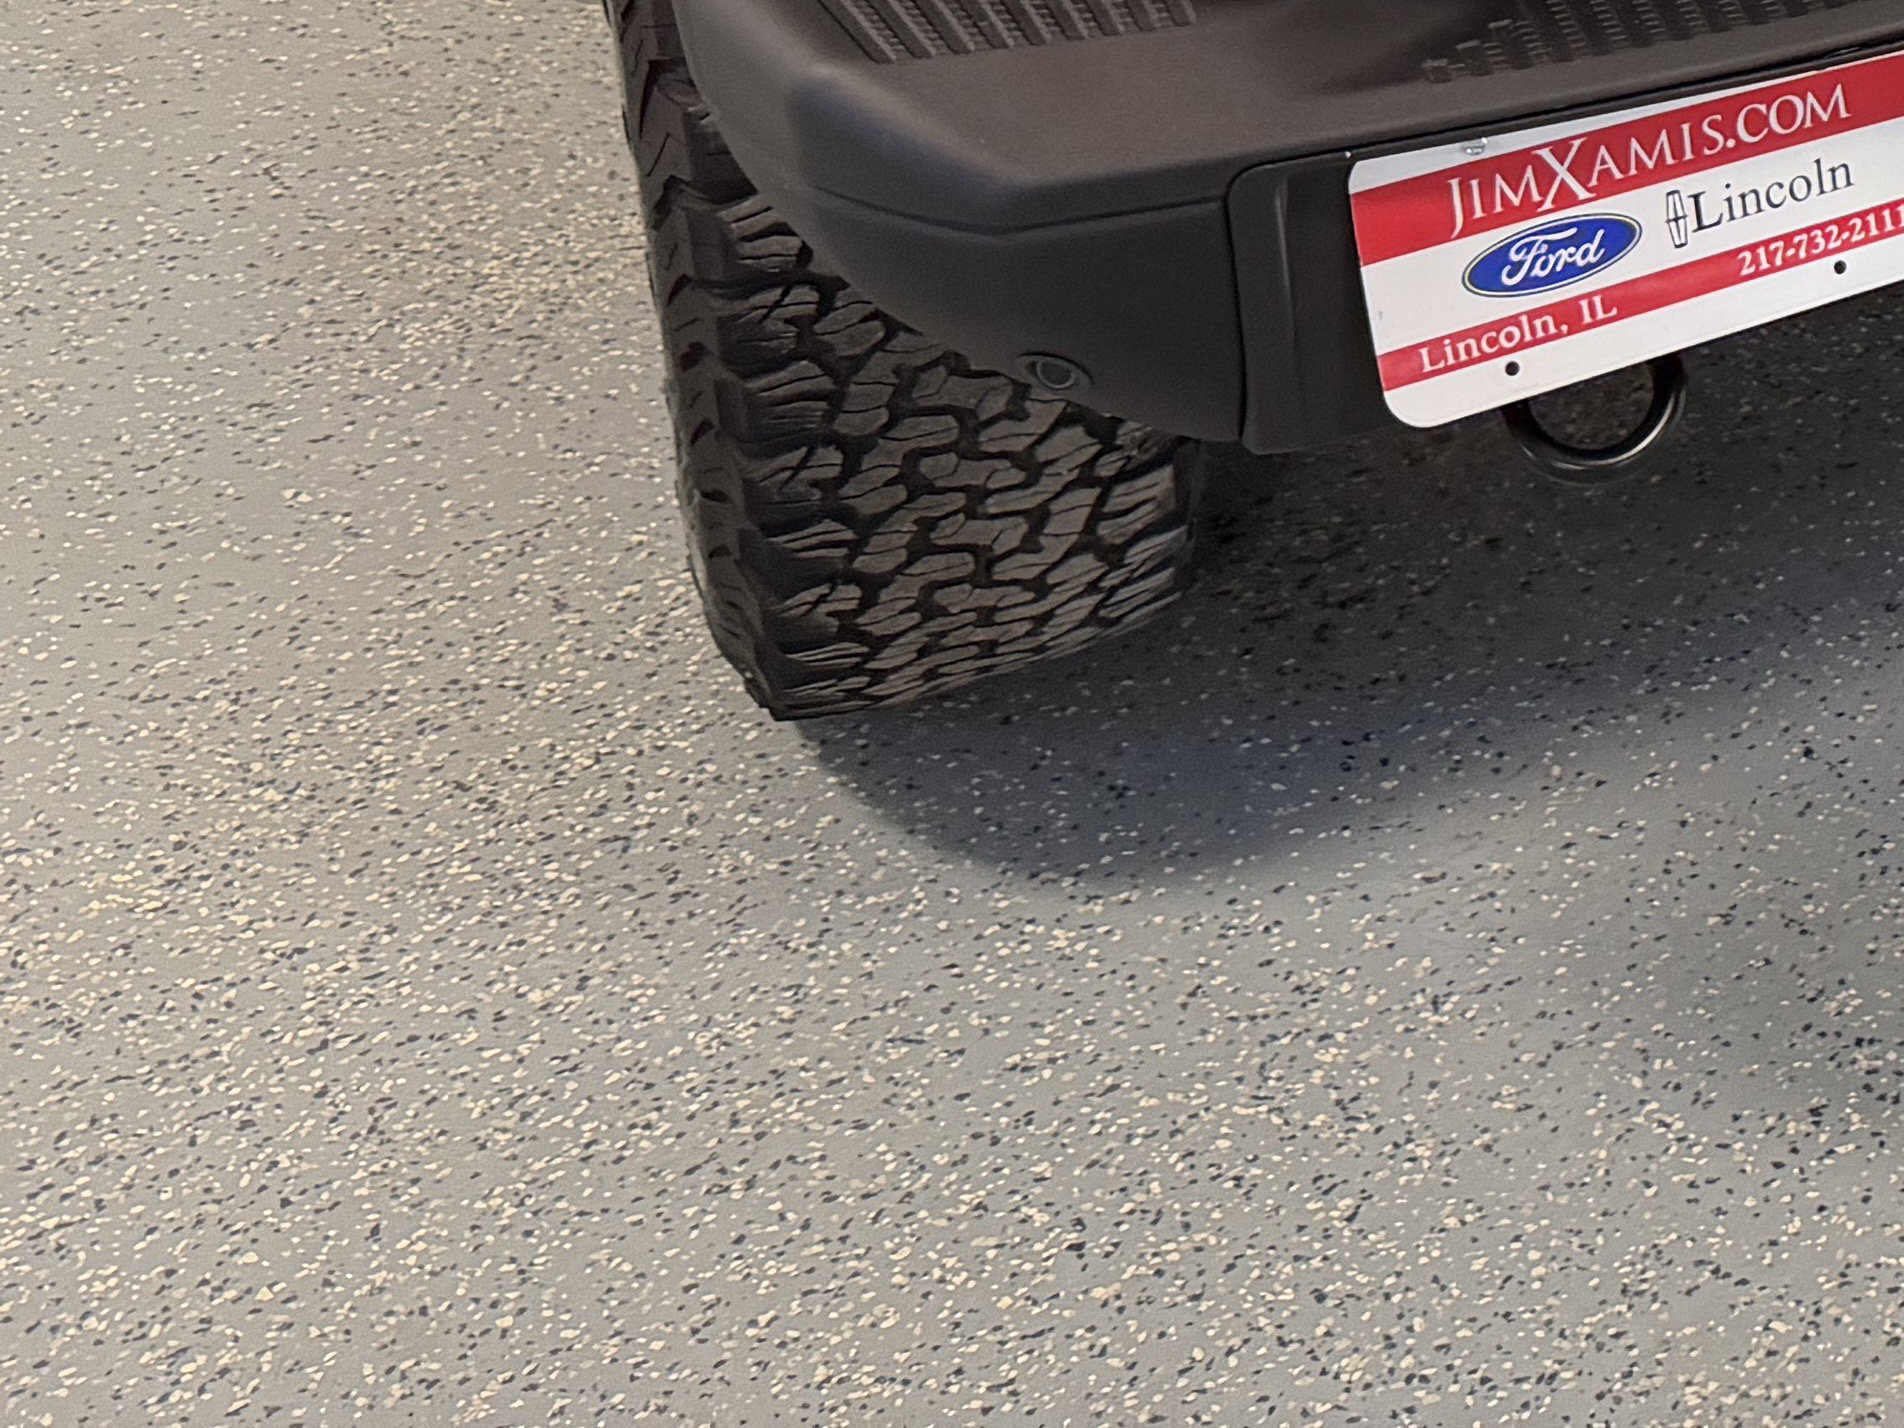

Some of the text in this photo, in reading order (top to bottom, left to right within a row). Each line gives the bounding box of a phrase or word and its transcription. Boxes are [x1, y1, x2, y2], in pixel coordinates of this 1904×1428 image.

[1448, 83, 1852, 239] JIMXAMIS.COM
[1688, 157, 1855, 233] Lincoln
[1501, 227, 1605, 286] Ford
[1419, 294, 1618, 373] Lincoln, IL
